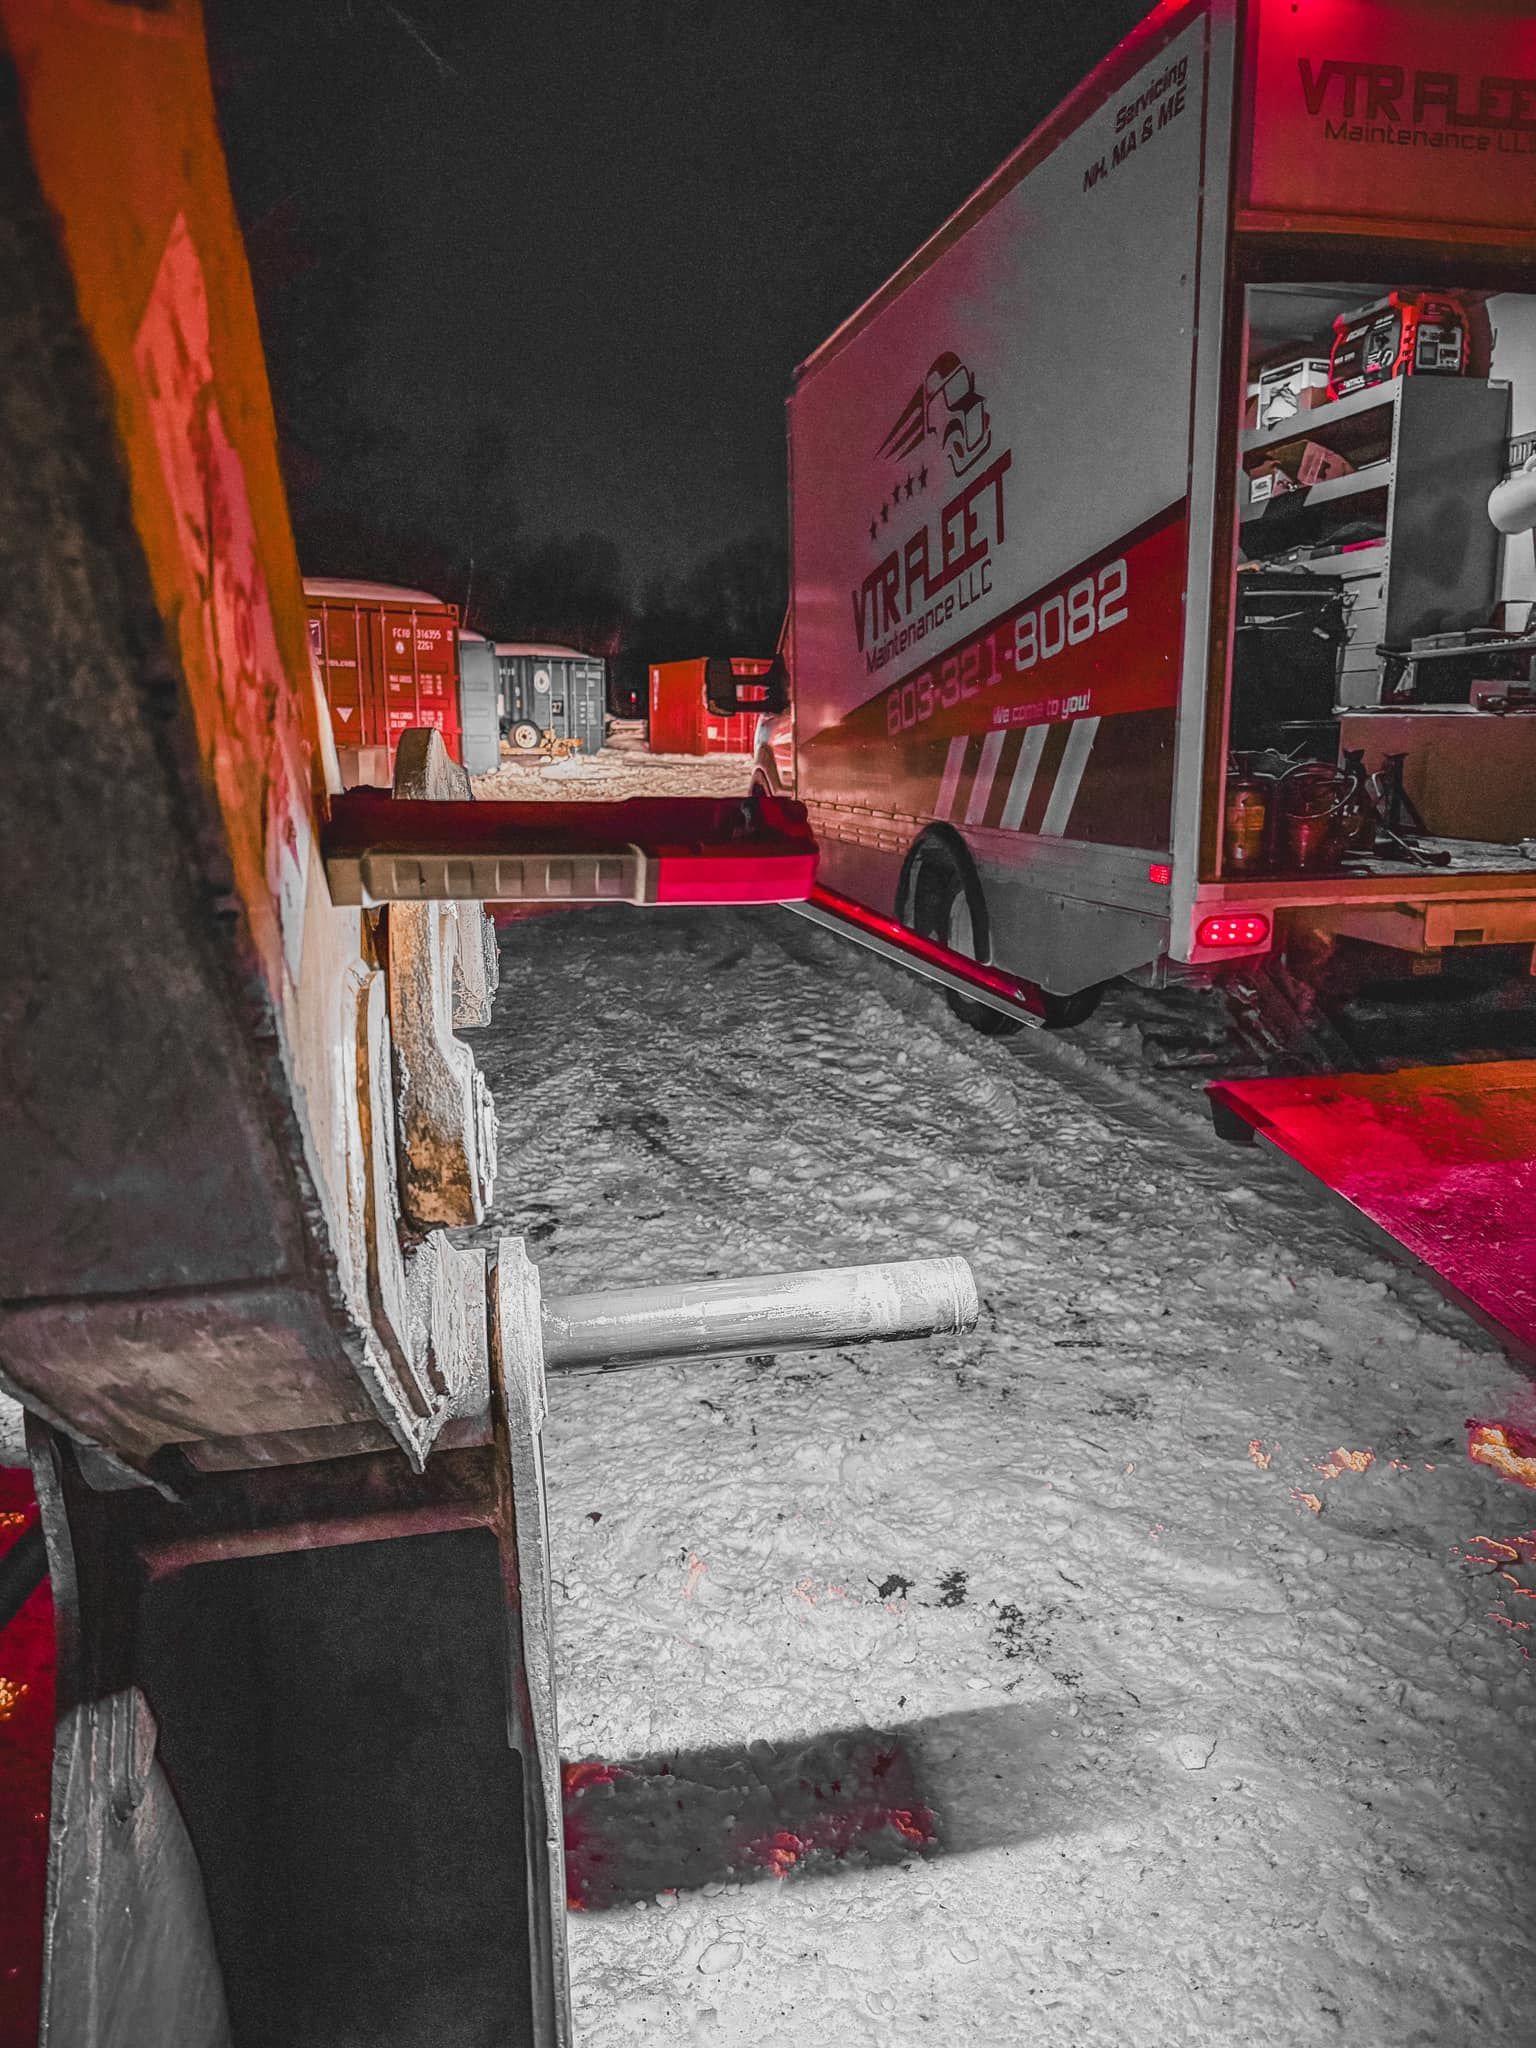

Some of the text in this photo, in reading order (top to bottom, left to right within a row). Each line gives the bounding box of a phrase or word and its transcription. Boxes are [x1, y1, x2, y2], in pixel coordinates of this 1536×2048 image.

[1111, 131, 1137, 170] MA
[1158, 84, 1188, 130] ME
[1115, 55, 1187, 133] Servicing
[1412, 69, 1536, 131] FLEE
[1324, 119, 1490, 151] Maintenance
[866, 558, 993, 674] Maintenance LLC
[886, 558, 1129, 737] 603-321-8082
[992, 688, 1092, 724] We come to you!
